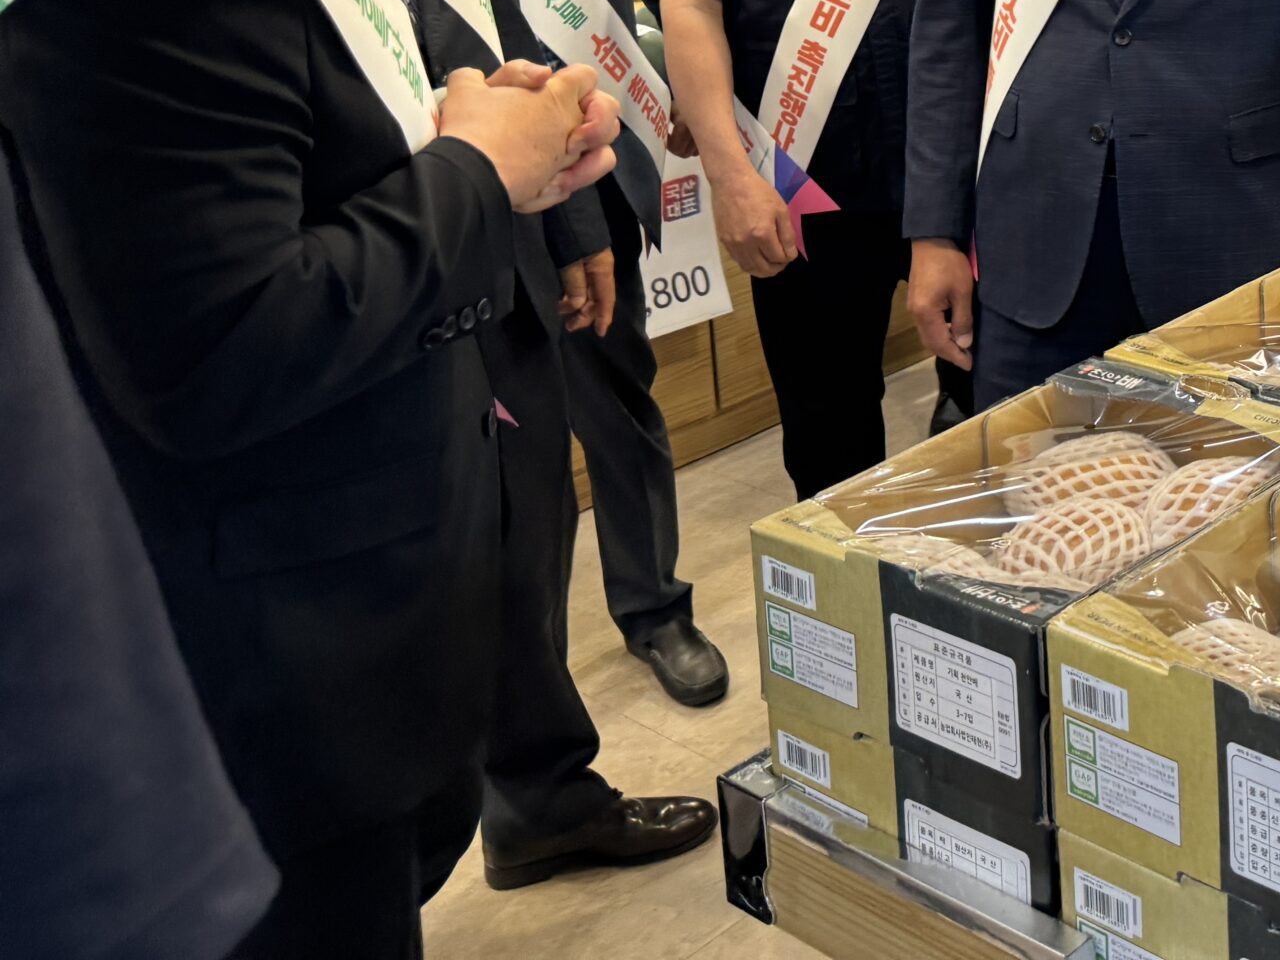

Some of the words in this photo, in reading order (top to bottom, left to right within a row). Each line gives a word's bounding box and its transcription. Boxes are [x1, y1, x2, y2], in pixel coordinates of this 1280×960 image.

[590, 33, 633, 84] 소비
[627, 73, 669, 140] 촉진행
[770, 38, 828, 153] 촉진행사
[1088, 366, 1146, 390] 천안배
[775, 648, 789, 660] GAP
[914, 653, 934, 670] 제품명
[933, 642, 972, 666] 표준규격품
[915, 671, 936, 688] 원산지
[955, 689, 973, 704] 국산
[916, 690, 936, 707] 입수
[916, 711, 937, 729] 공급처
[1074, 769, 1092, 784] GAP
[1250, 786, 1267, 801] 품목
[1250, 825, 1268, 840] 등급
[955, 843, 973, 858] 원산지
[980, 855, 997, 869] 국산
[1250, 843, 1268, 858] 중량
[1250, 859, 1269, 874] 입수
